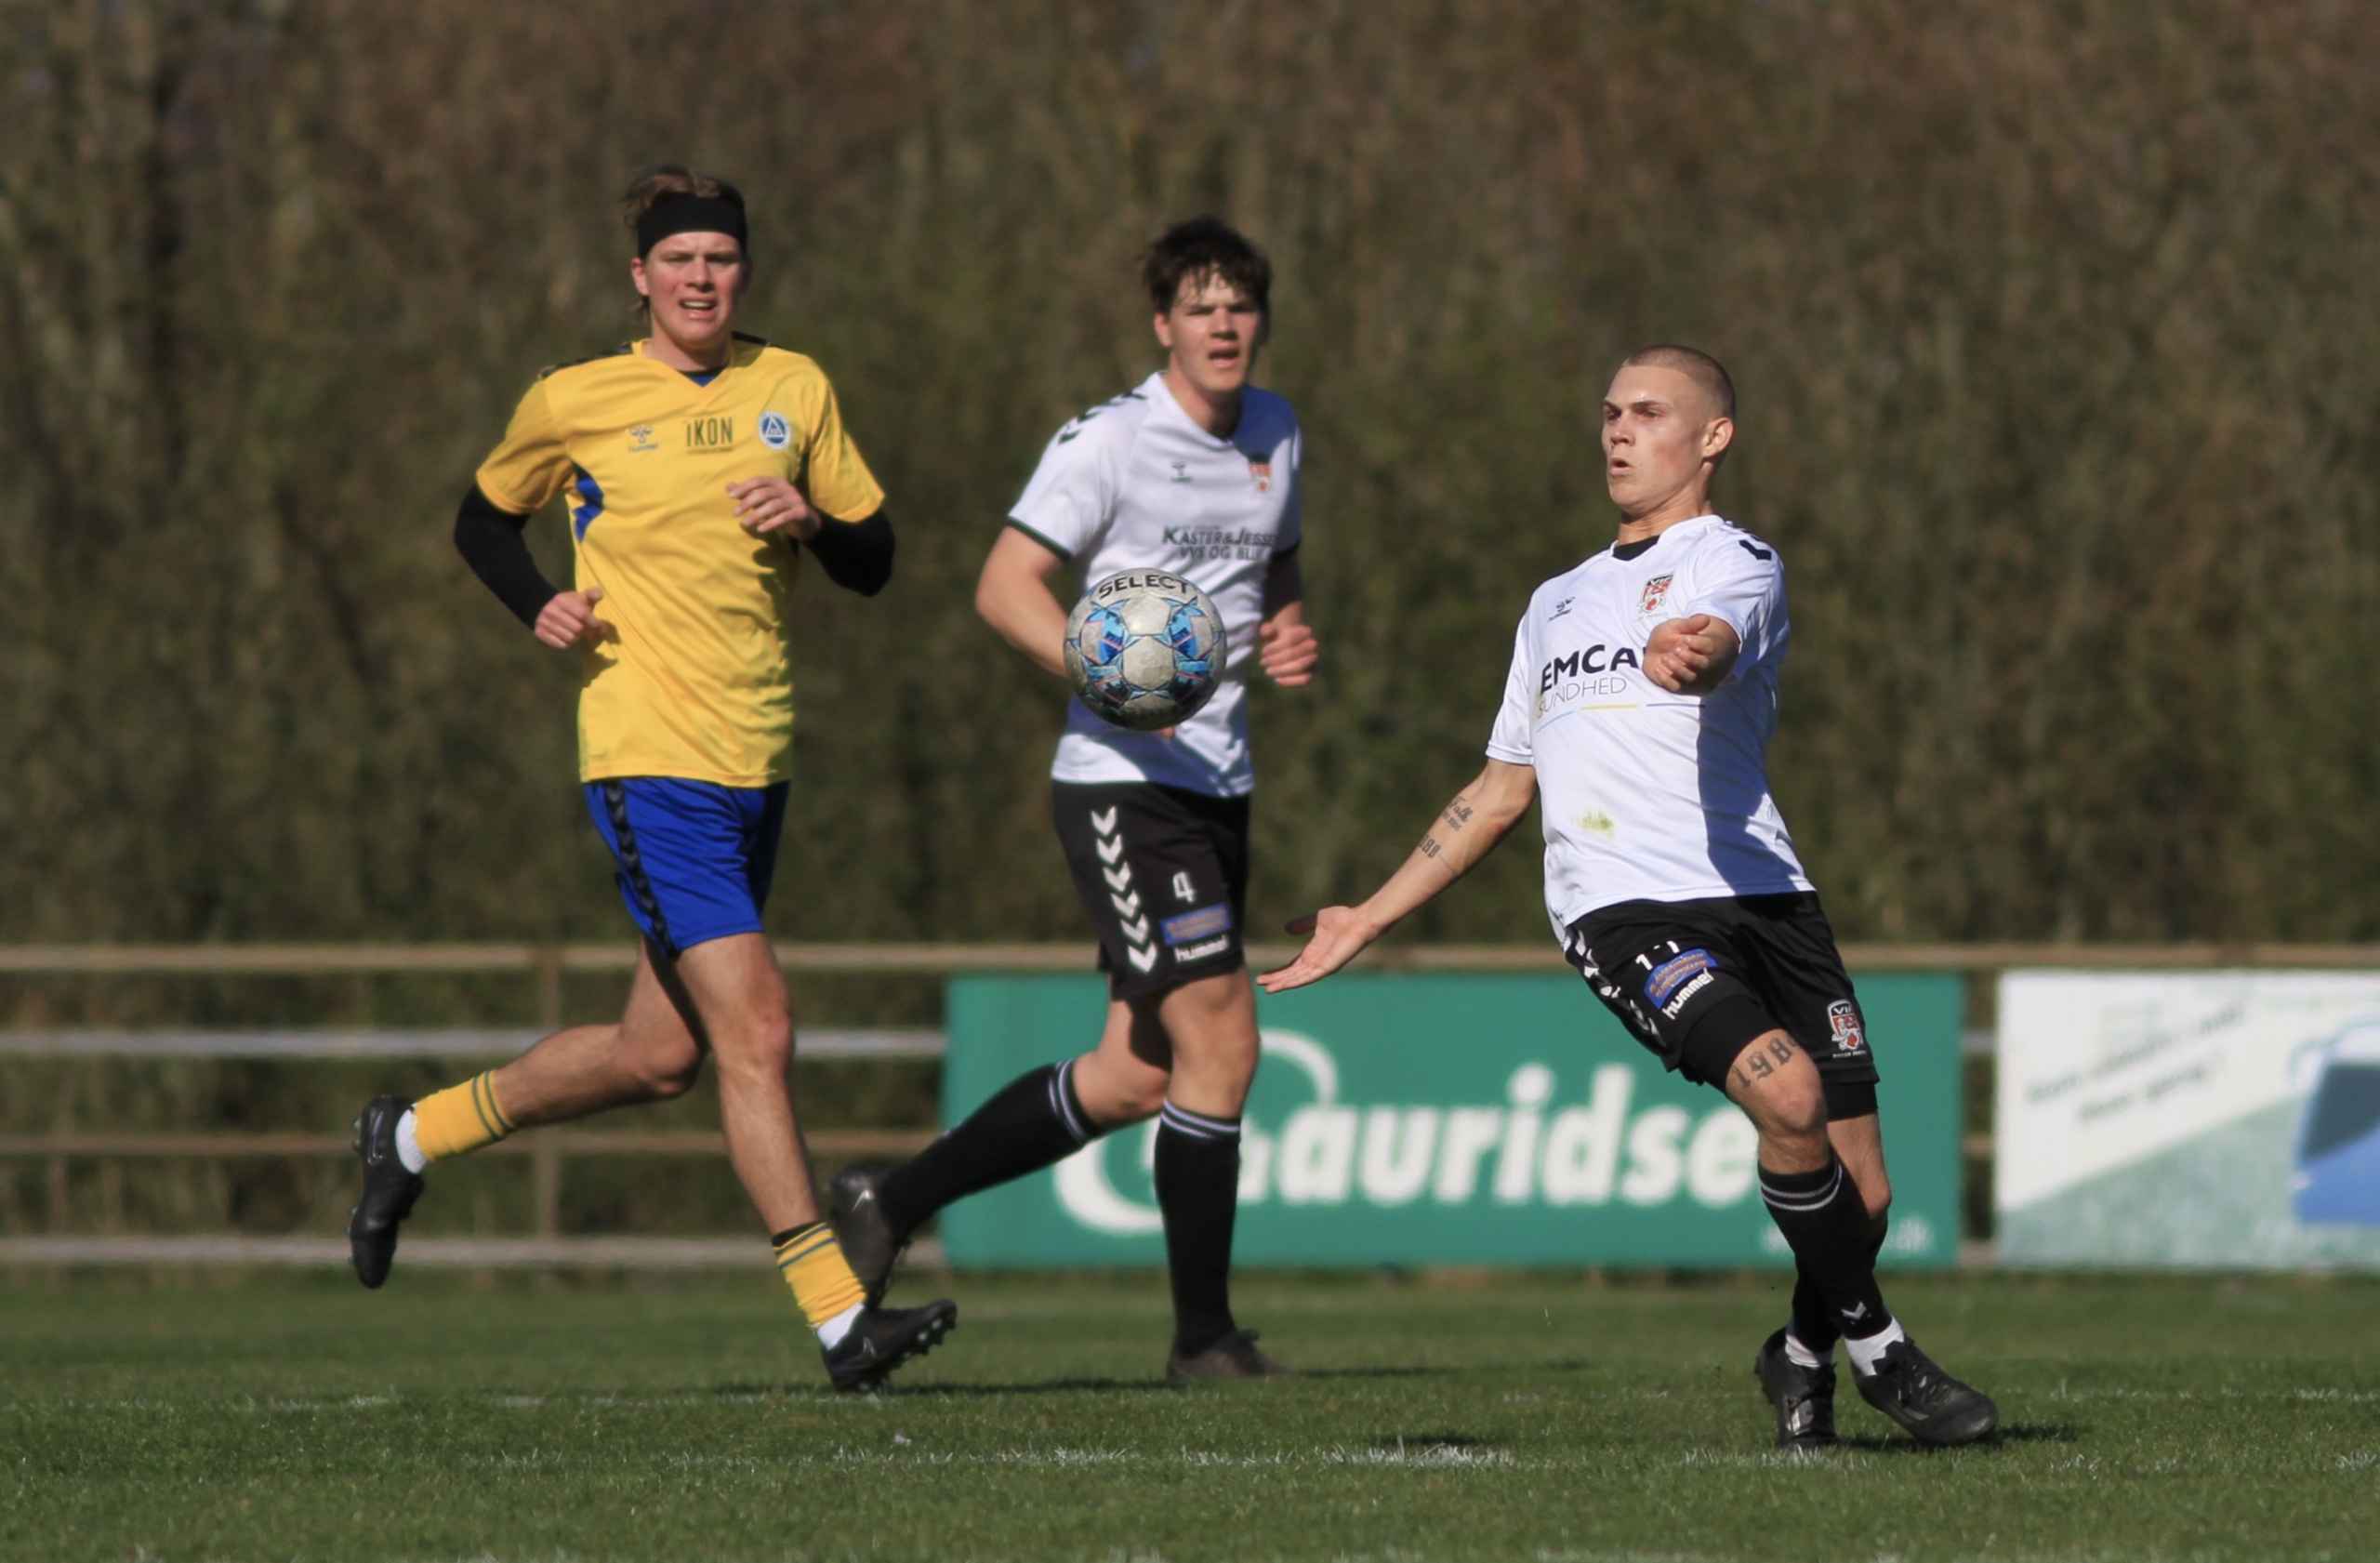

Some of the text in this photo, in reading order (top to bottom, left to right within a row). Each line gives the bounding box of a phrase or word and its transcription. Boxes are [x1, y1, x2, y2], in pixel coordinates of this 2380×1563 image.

[1210, 545, 1231, 560] OG
[1099, 574, 1190, 600] SELECT
[1540, 643, 1646, 695] EMCA
[1172, 870, 1196, 903] 4
[1661, 966, 1715, 1020] hummel
